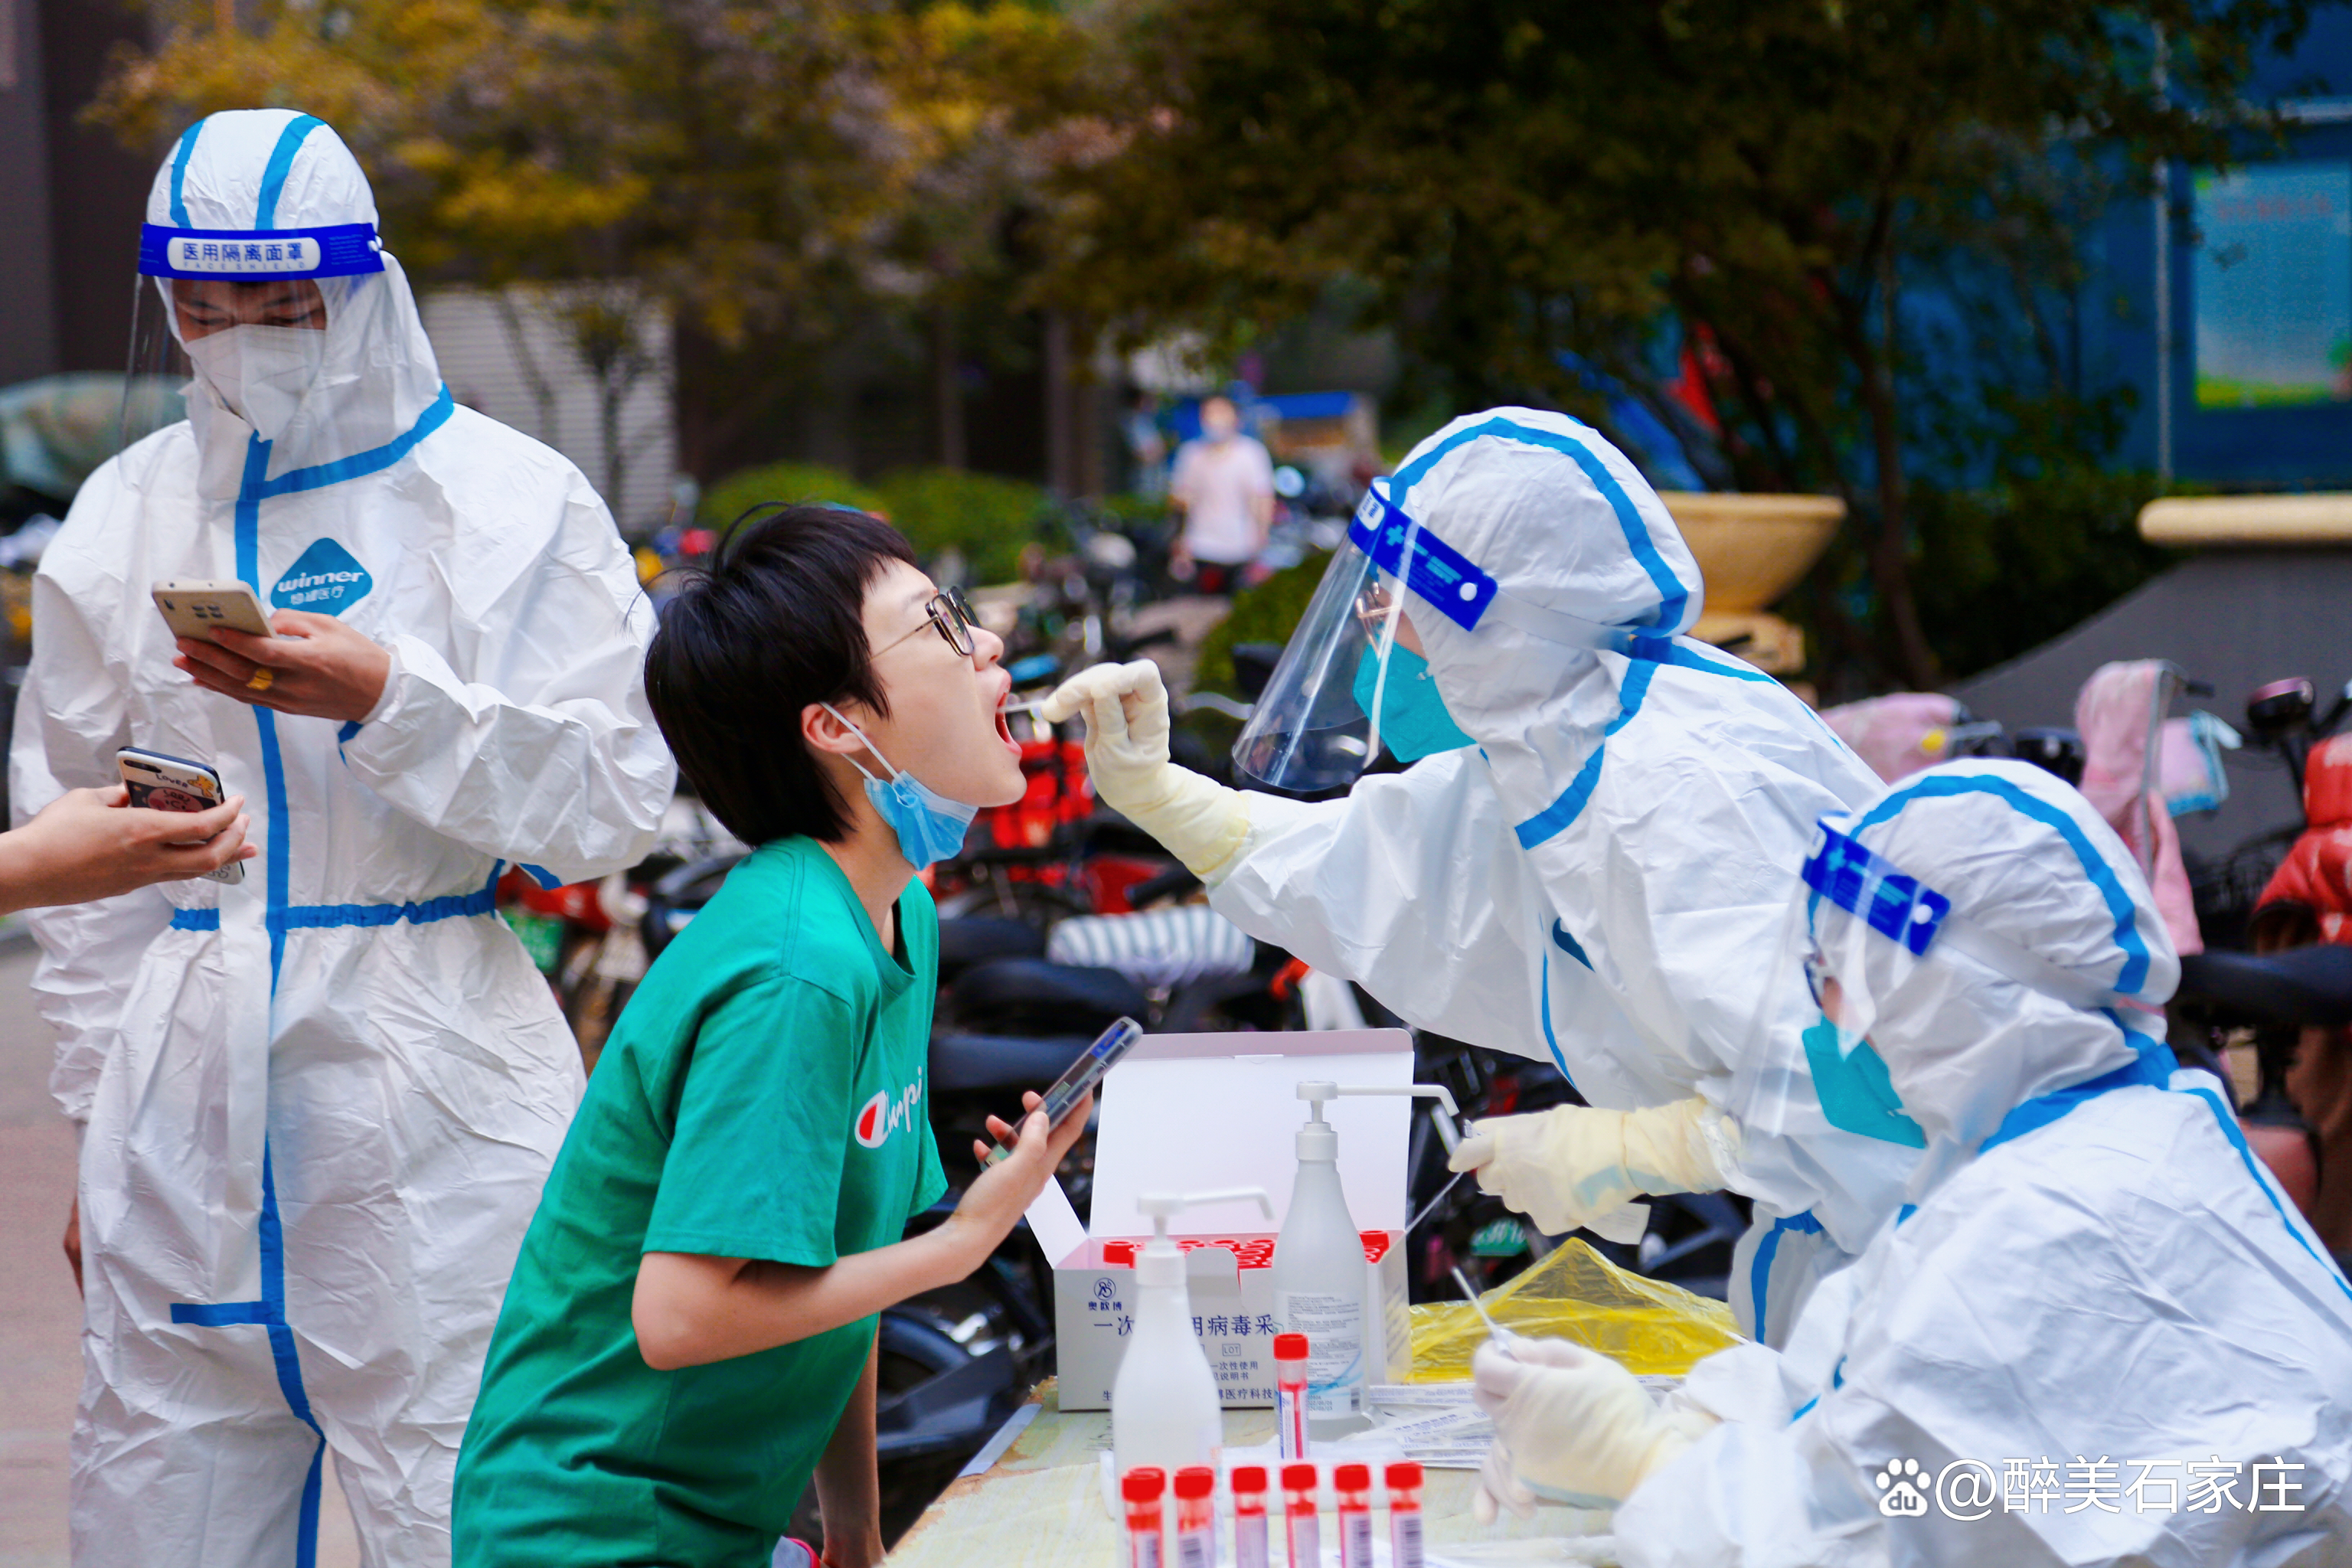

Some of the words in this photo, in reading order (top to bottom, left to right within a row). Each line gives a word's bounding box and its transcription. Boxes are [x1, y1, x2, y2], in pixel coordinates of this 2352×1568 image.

[183, 242, 303, 262] 医用隔离面罩
[277, 571, 364, 593] winner
[1224, 1346, 1240, 1354] LOT
[1209, 1361, 1259, 1370] 一次性使用
